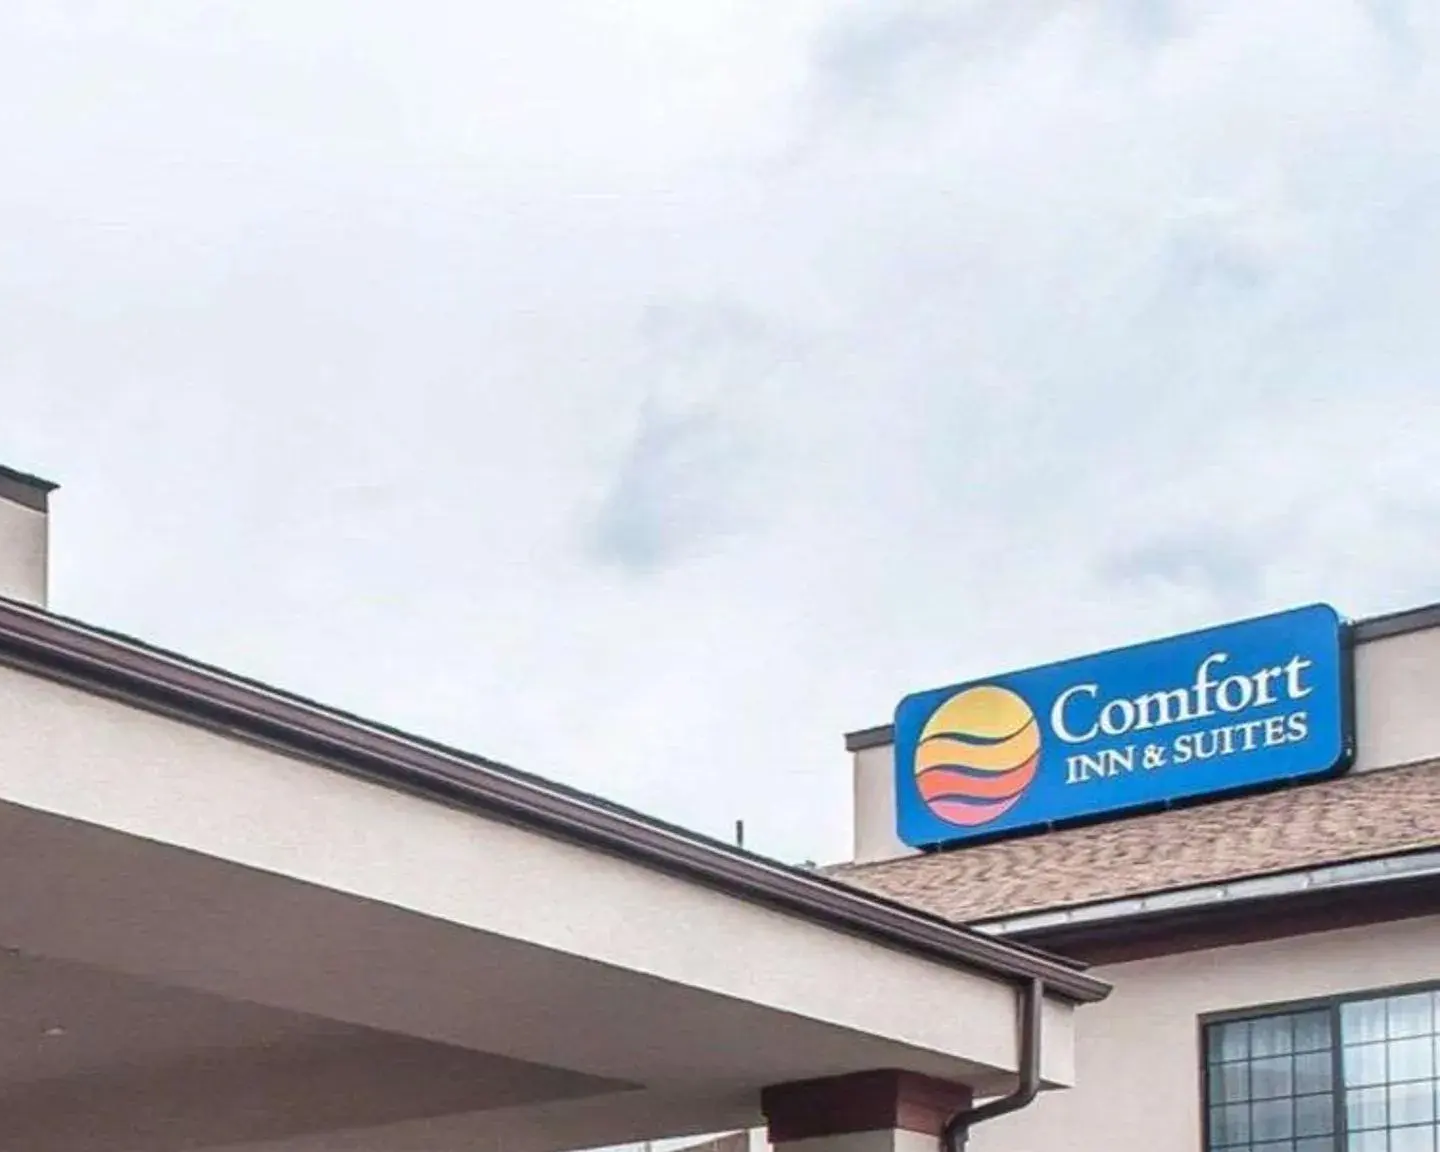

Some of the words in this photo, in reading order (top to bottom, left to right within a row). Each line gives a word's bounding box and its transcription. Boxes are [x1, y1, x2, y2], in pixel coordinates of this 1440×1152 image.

[1050, 652, 1313, 743] Comfort
[1065, 744, 1135, 784] INN
[1142, 744, 1166, 768] &
[1173, 711, 1309, 764] SUITES
